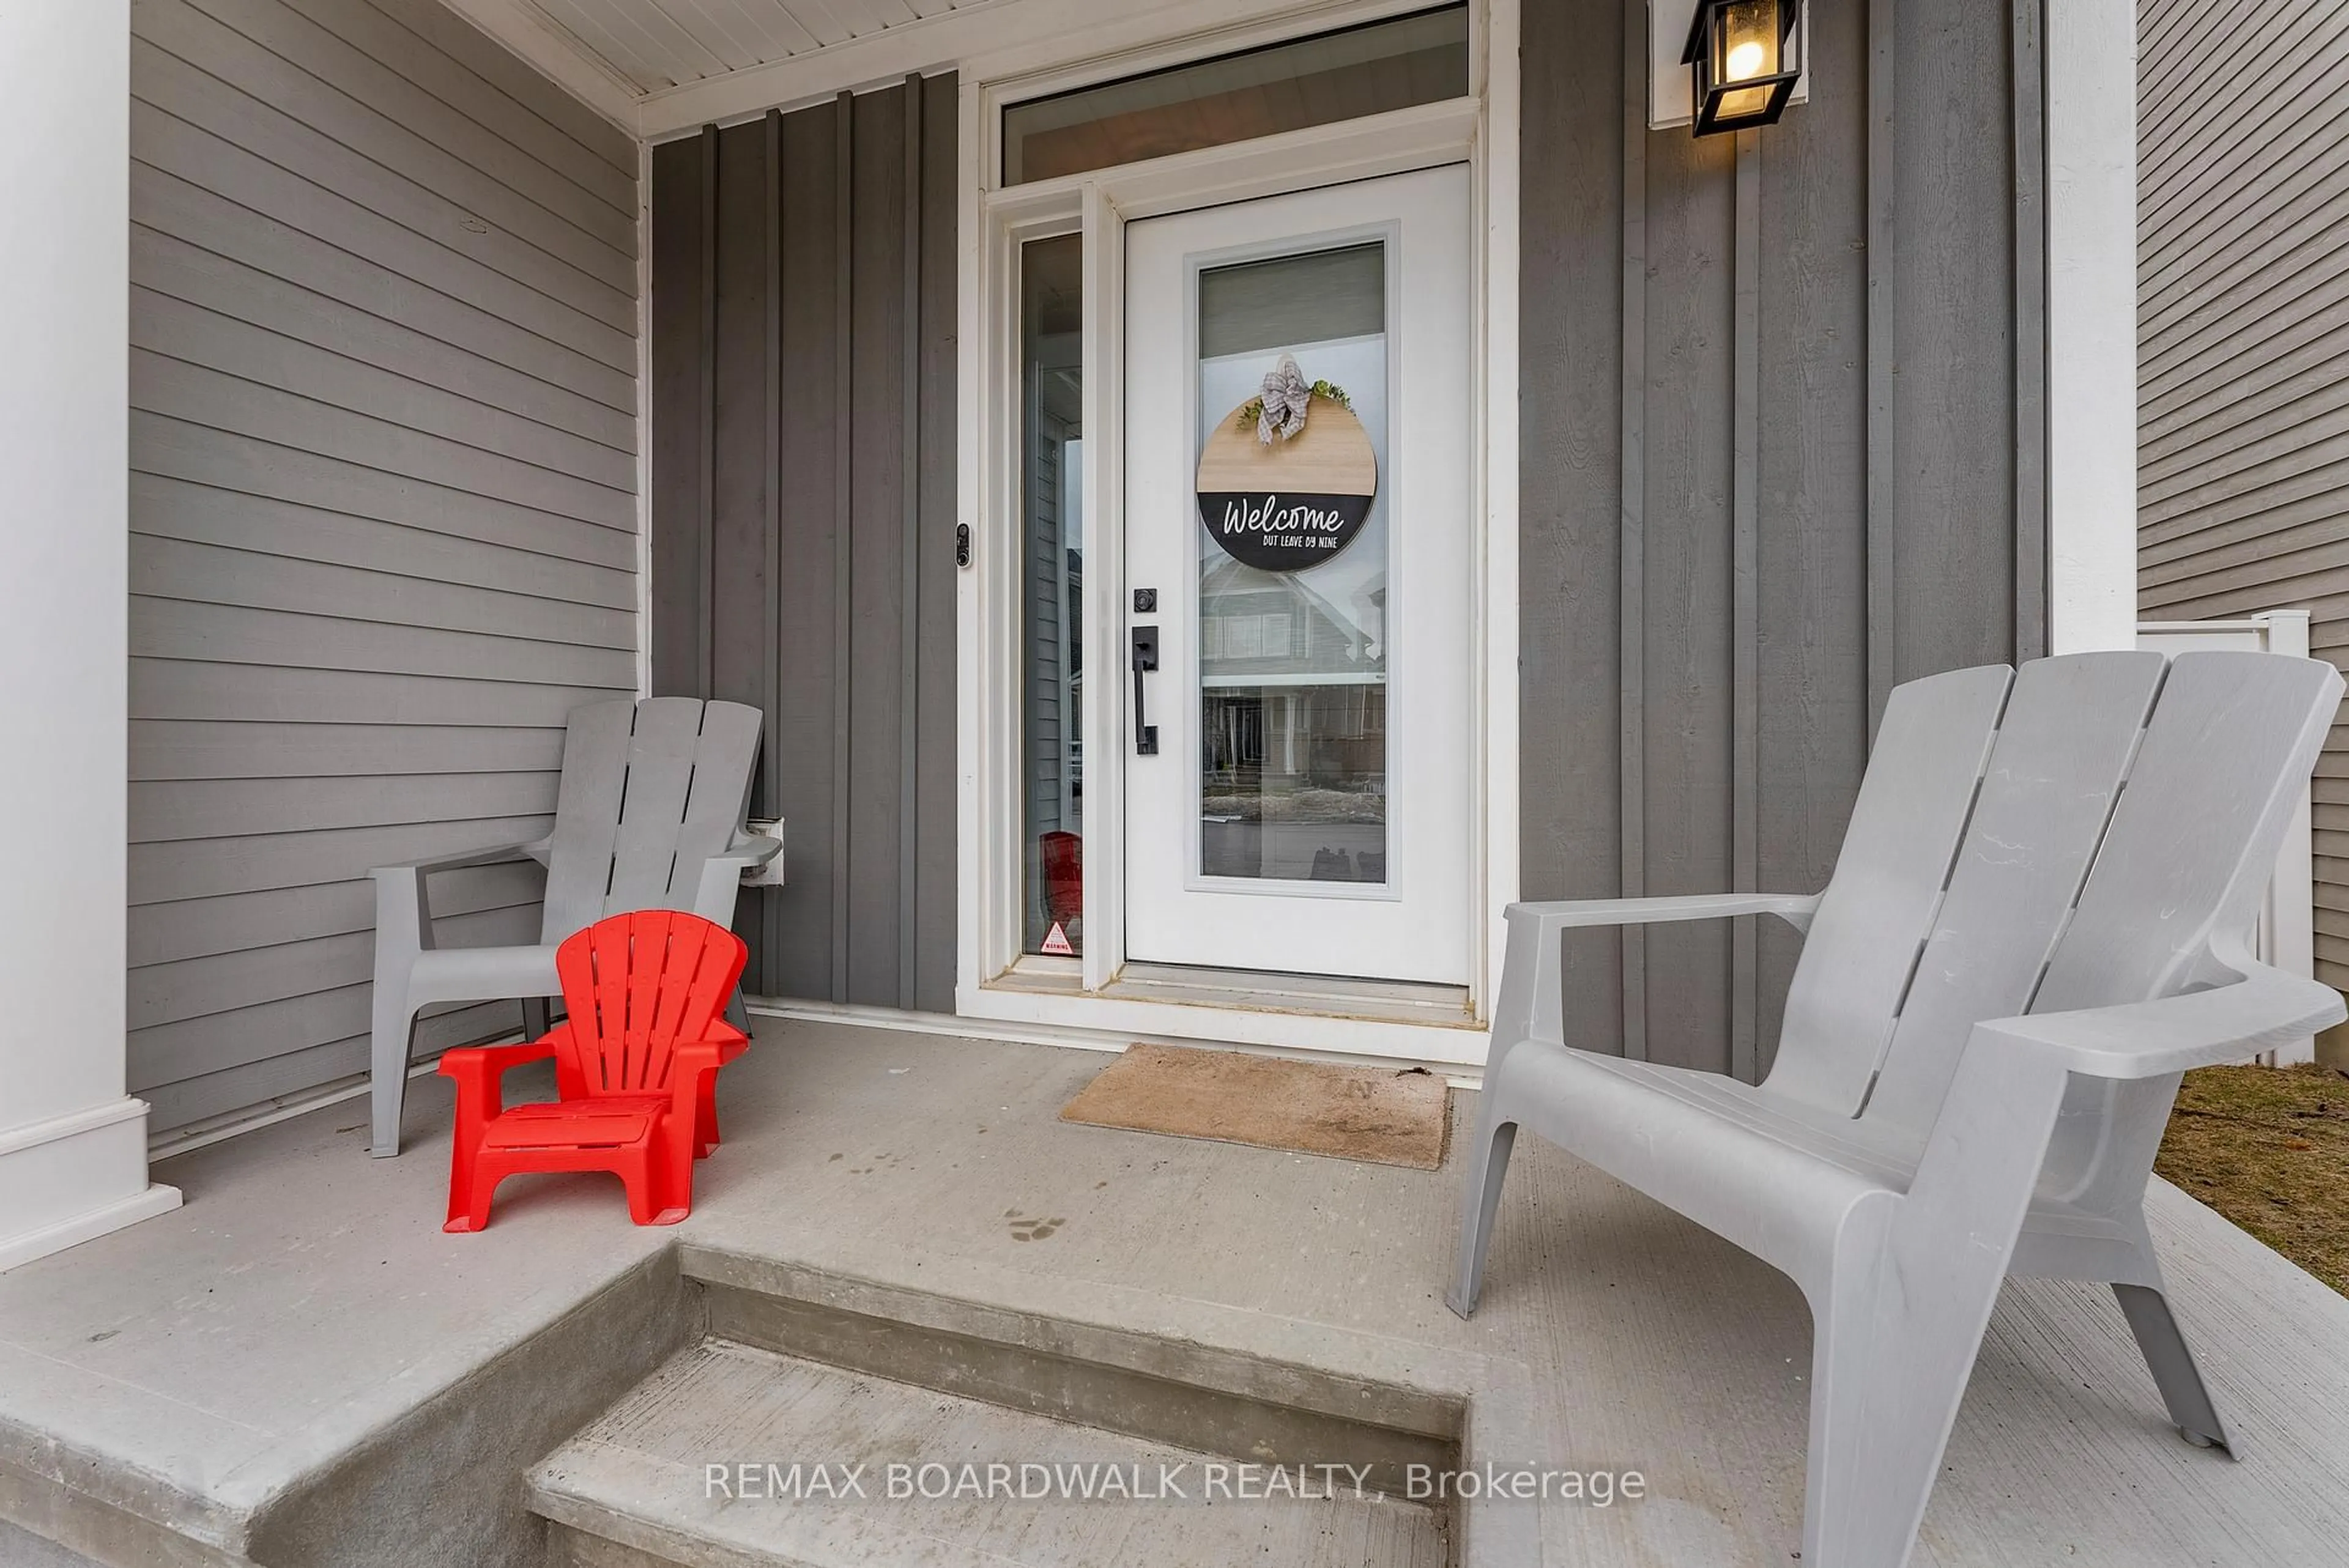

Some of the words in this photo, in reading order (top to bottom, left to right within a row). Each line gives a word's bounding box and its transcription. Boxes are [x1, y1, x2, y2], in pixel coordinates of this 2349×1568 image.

[1224, 495, 1344, 534] Welcome
[1263, 535, 1278, 546] BUT
[1280, 536, 1303, 547] LEAVE
[1305, 536, 1316, 548] BY
[1318, 537, 1338, 549] NINE
